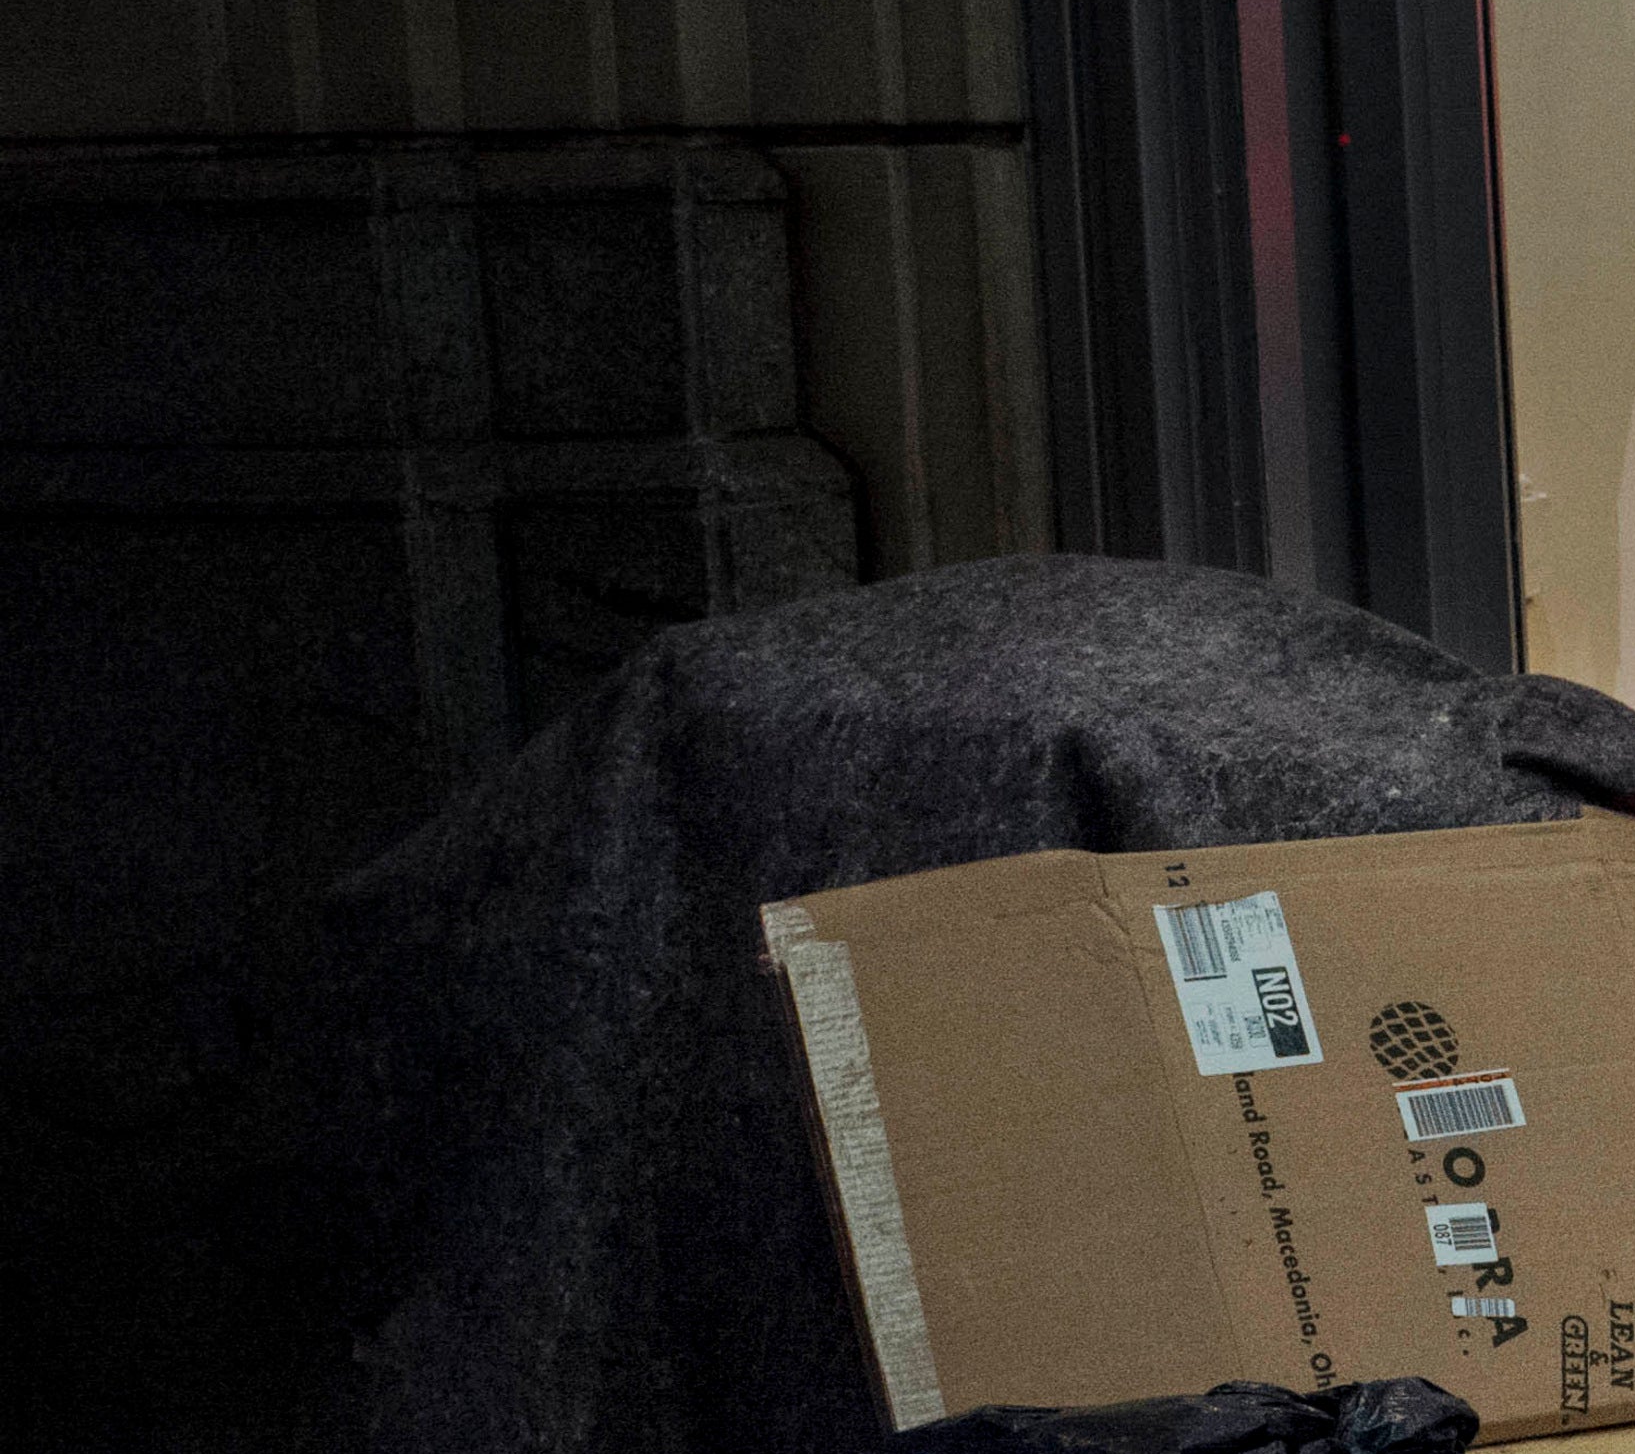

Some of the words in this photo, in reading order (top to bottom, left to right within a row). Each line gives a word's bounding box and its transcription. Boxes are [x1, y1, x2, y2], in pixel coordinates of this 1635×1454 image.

[1233, 1071, 1267, 1124] land
[1249, 1131, 1285, 1198] Road,
[1433, 1223, 1452, 1246] 087
[1269, 1208, 1320, 1345] Macedonia,
[1310, 1353, 1337, 1389] Oh
[1562, 1315, 1589, 1415] GREEN
[1590, 1350, 1608, 1367] &
[1610, 1300, 1635, 1391] LEAN
